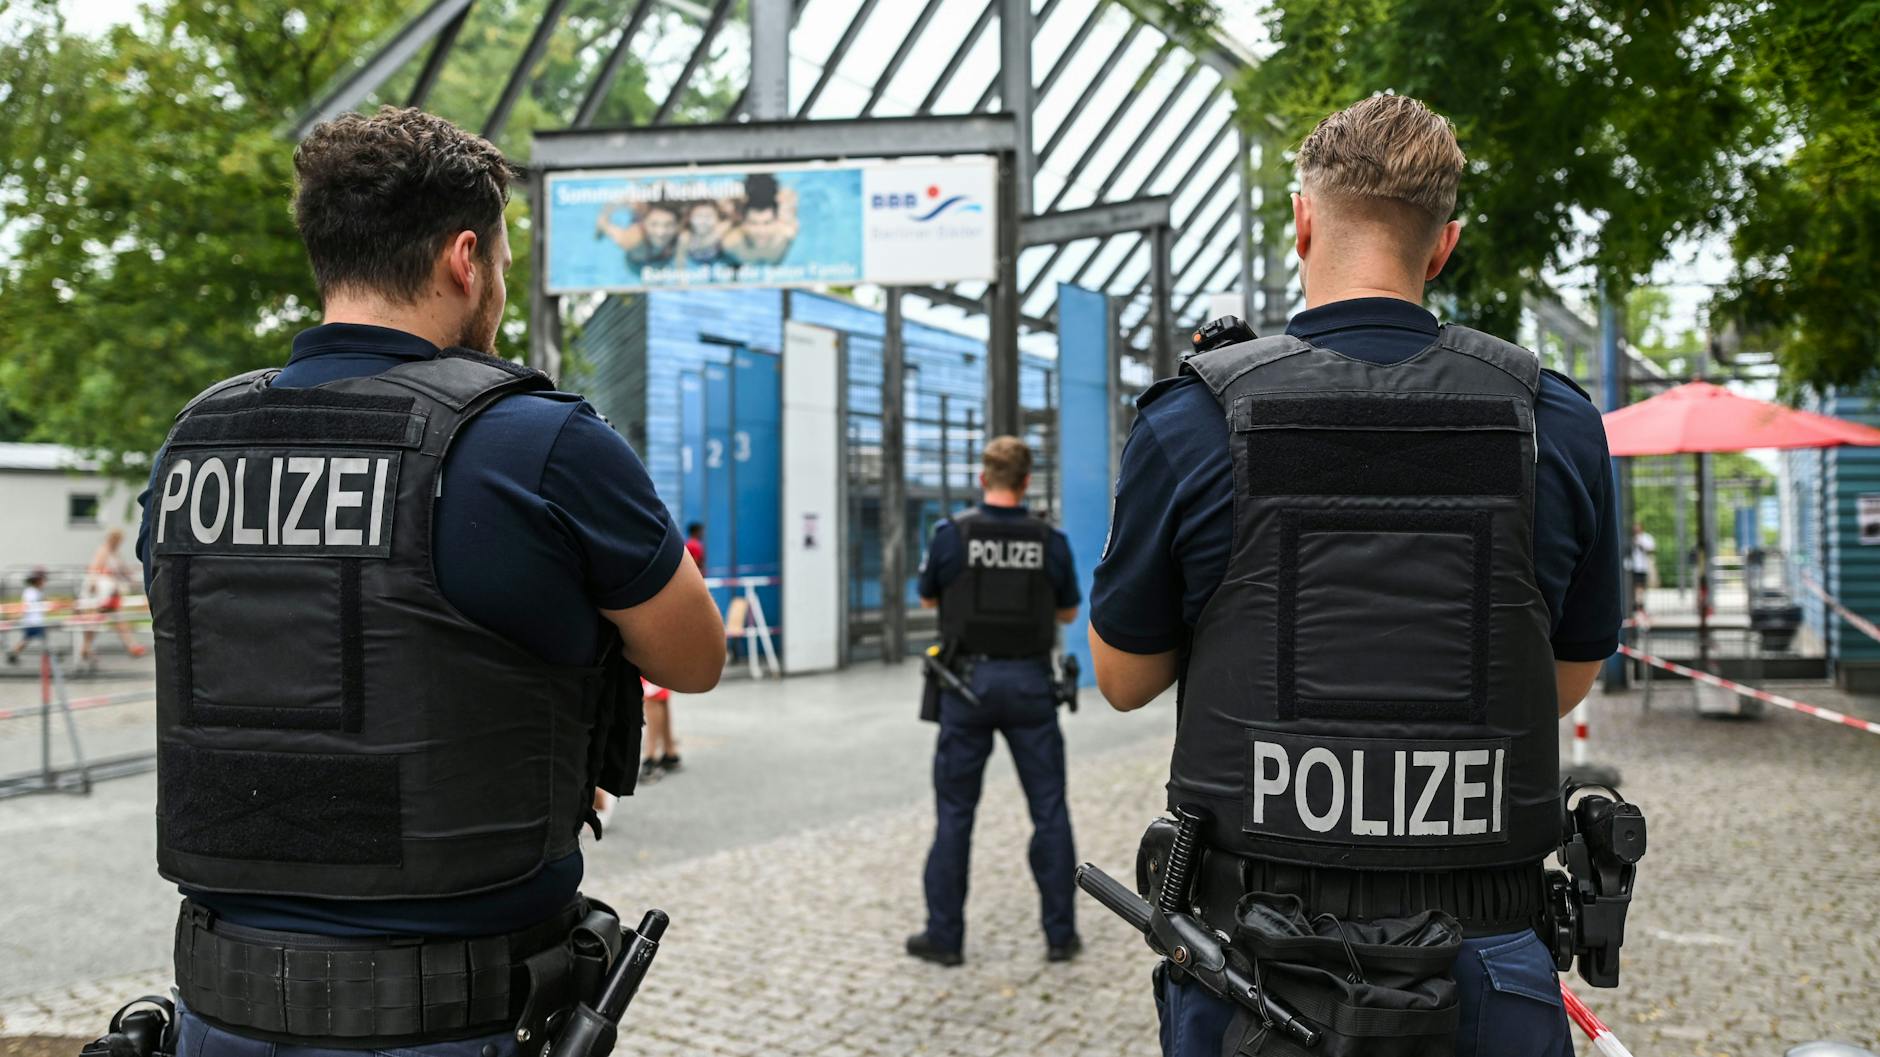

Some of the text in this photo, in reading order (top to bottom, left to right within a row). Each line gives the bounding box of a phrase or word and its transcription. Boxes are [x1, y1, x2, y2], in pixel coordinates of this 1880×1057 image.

[682, 446, 693, 473] 1
[706, 438, 723, 468] 2
[733, 431, 751, 462] 3
[157, 457, 389, 546] POLIZEI
[968, 539, 1043, 569] POLIZEI
[1253, 740, 1504, 836] POLIZEI
